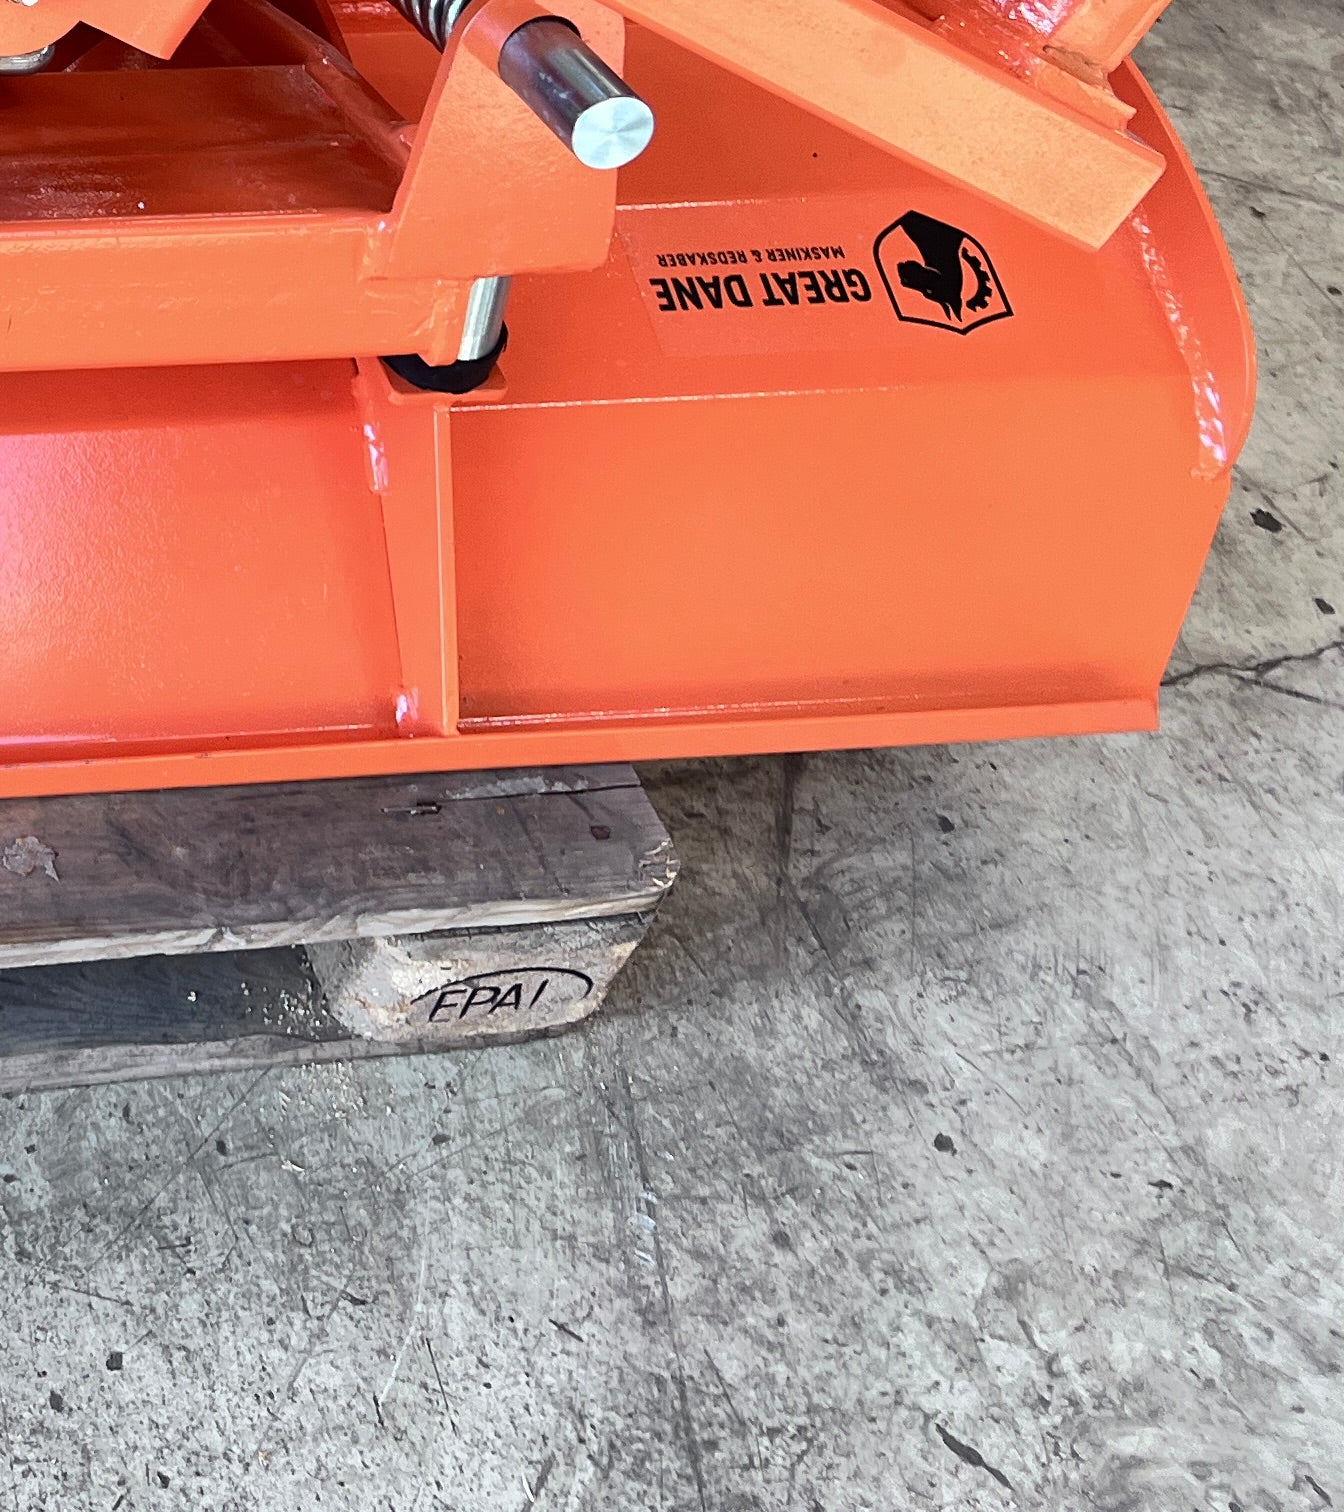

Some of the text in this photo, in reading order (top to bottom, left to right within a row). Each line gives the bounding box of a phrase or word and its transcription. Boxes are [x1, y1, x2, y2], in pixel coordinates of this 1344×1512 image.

[656, 245, 846, 268] MASKINER & REDSKABER
[649, 268, 873, 312] GREAT DANE
